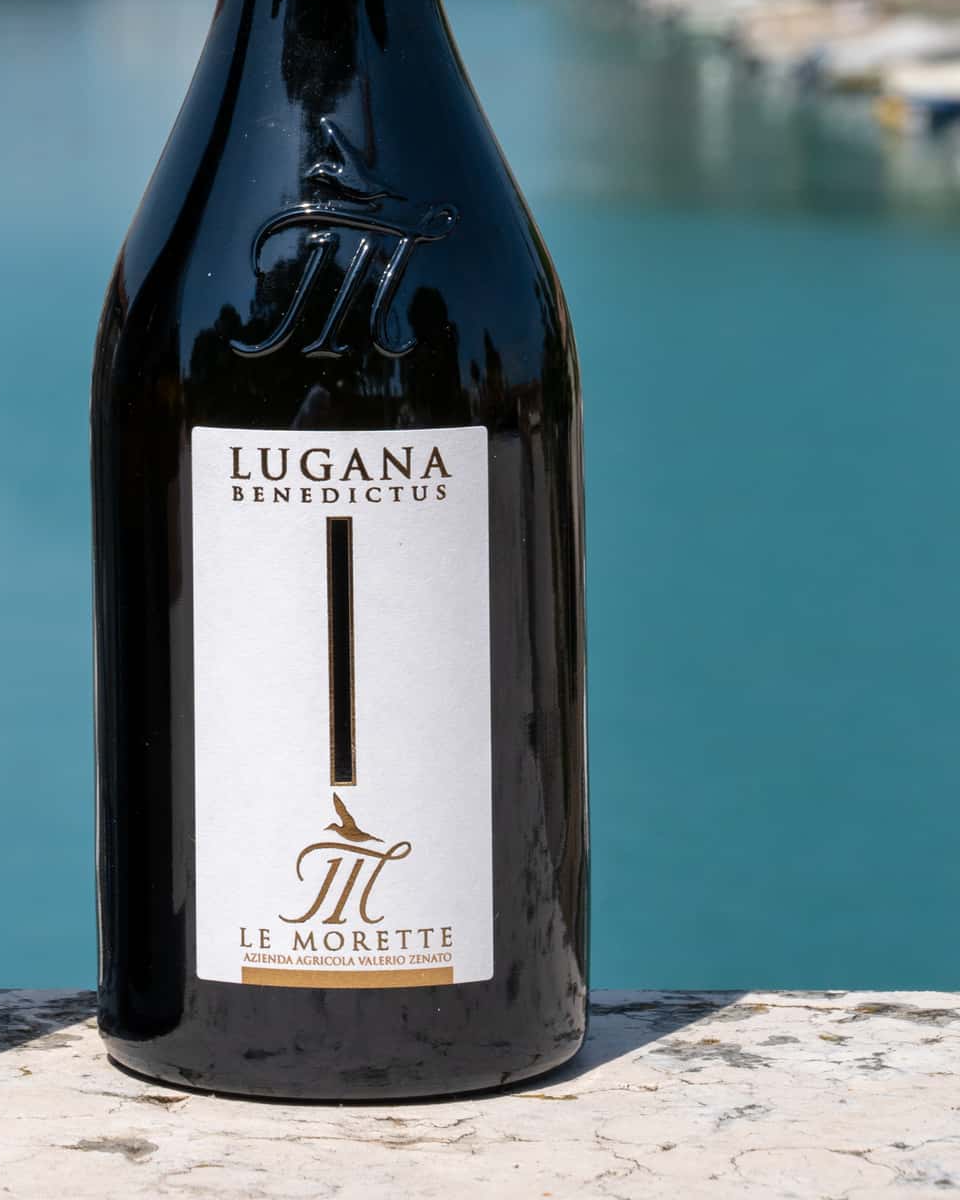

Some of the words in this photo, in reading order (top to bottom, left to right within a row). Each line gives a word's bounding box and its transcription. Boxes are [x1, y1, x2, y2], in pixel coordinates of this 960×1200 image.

[229, 446, 453, 481] LUGANA
[231, 484, 448, 504] BENEDICTUS
[240, 927, 271, 949] LE
[292, 926, 453, 951] MORETTE
[243, 953, 292, 965] AZIENDA
[296, 955, 355, 967] AGRICOLA
[357, 955, 406, 966] VALERIO
[409, 953, 452, 965] ZENATO
